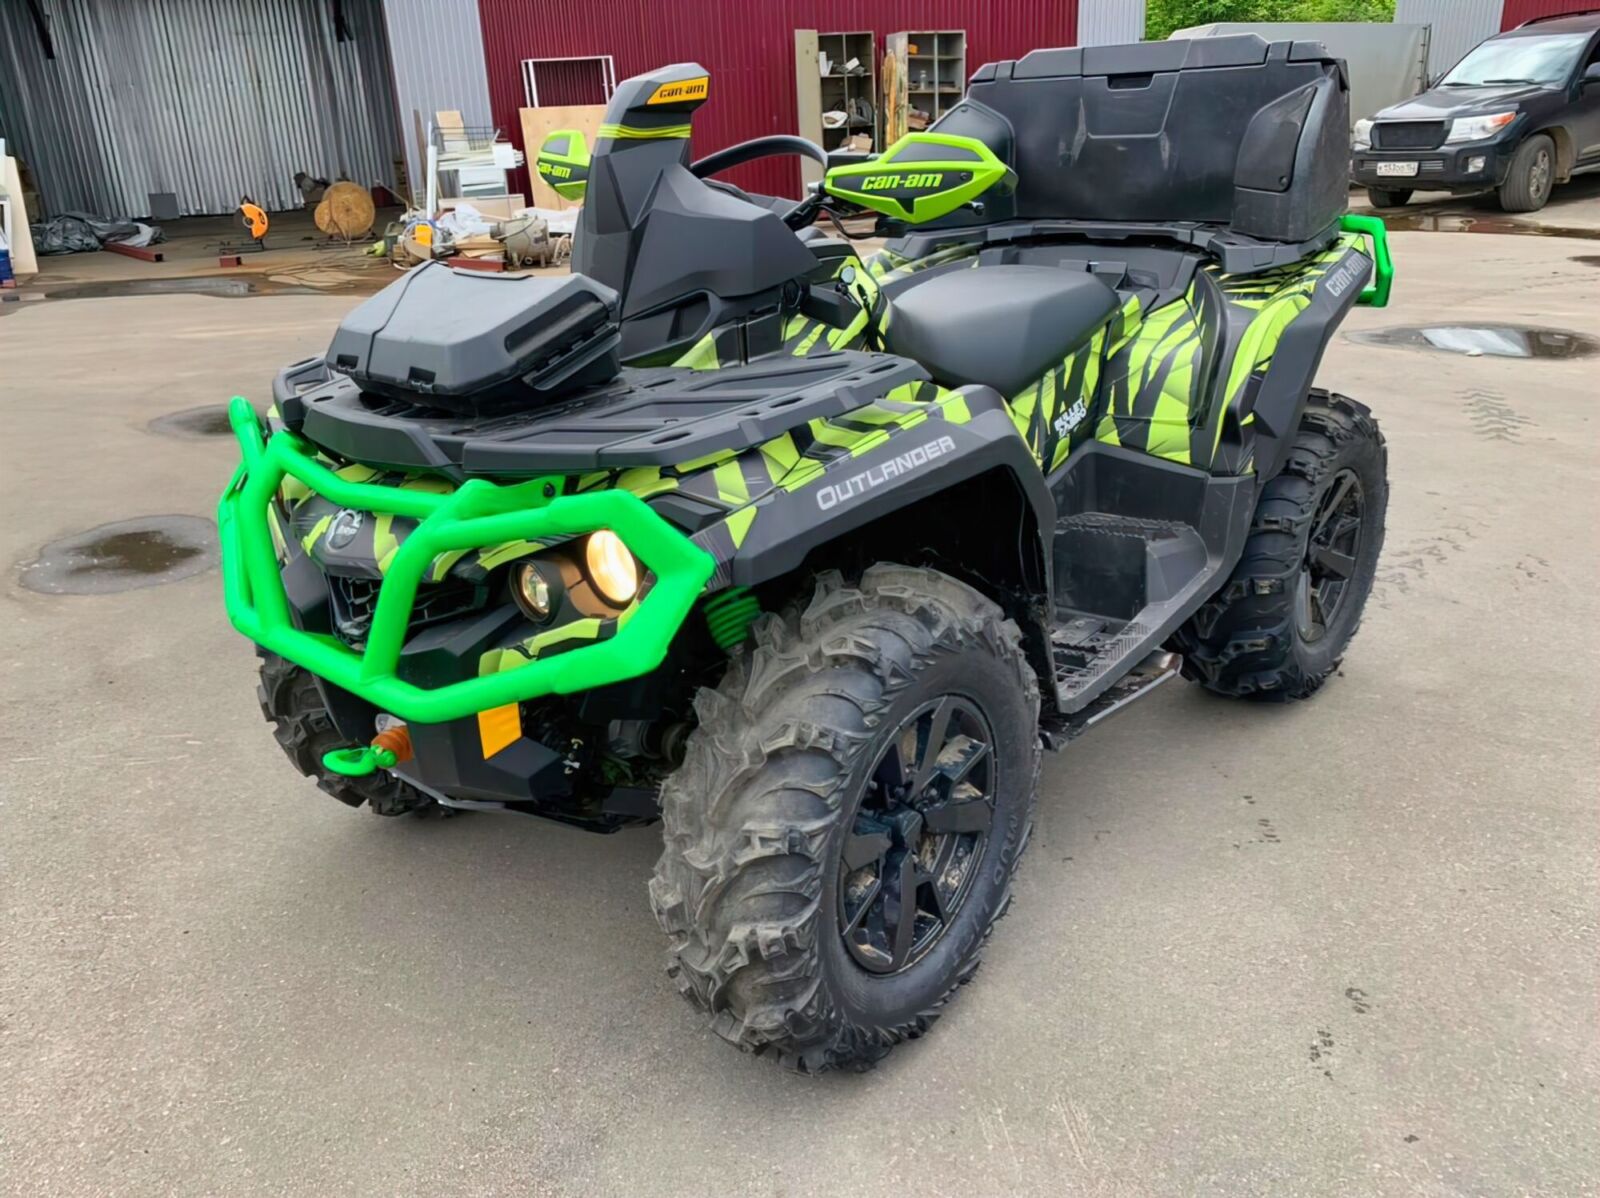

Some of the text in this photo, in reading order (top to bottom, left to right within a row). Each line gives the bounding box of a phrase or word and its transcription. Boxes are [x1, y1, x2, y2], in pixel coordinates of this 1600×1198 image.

[660, 84, 705, 98] can-am
[861, 173, 943, 191] can-am
[816, 435, 956, 511] OUTLANDER
